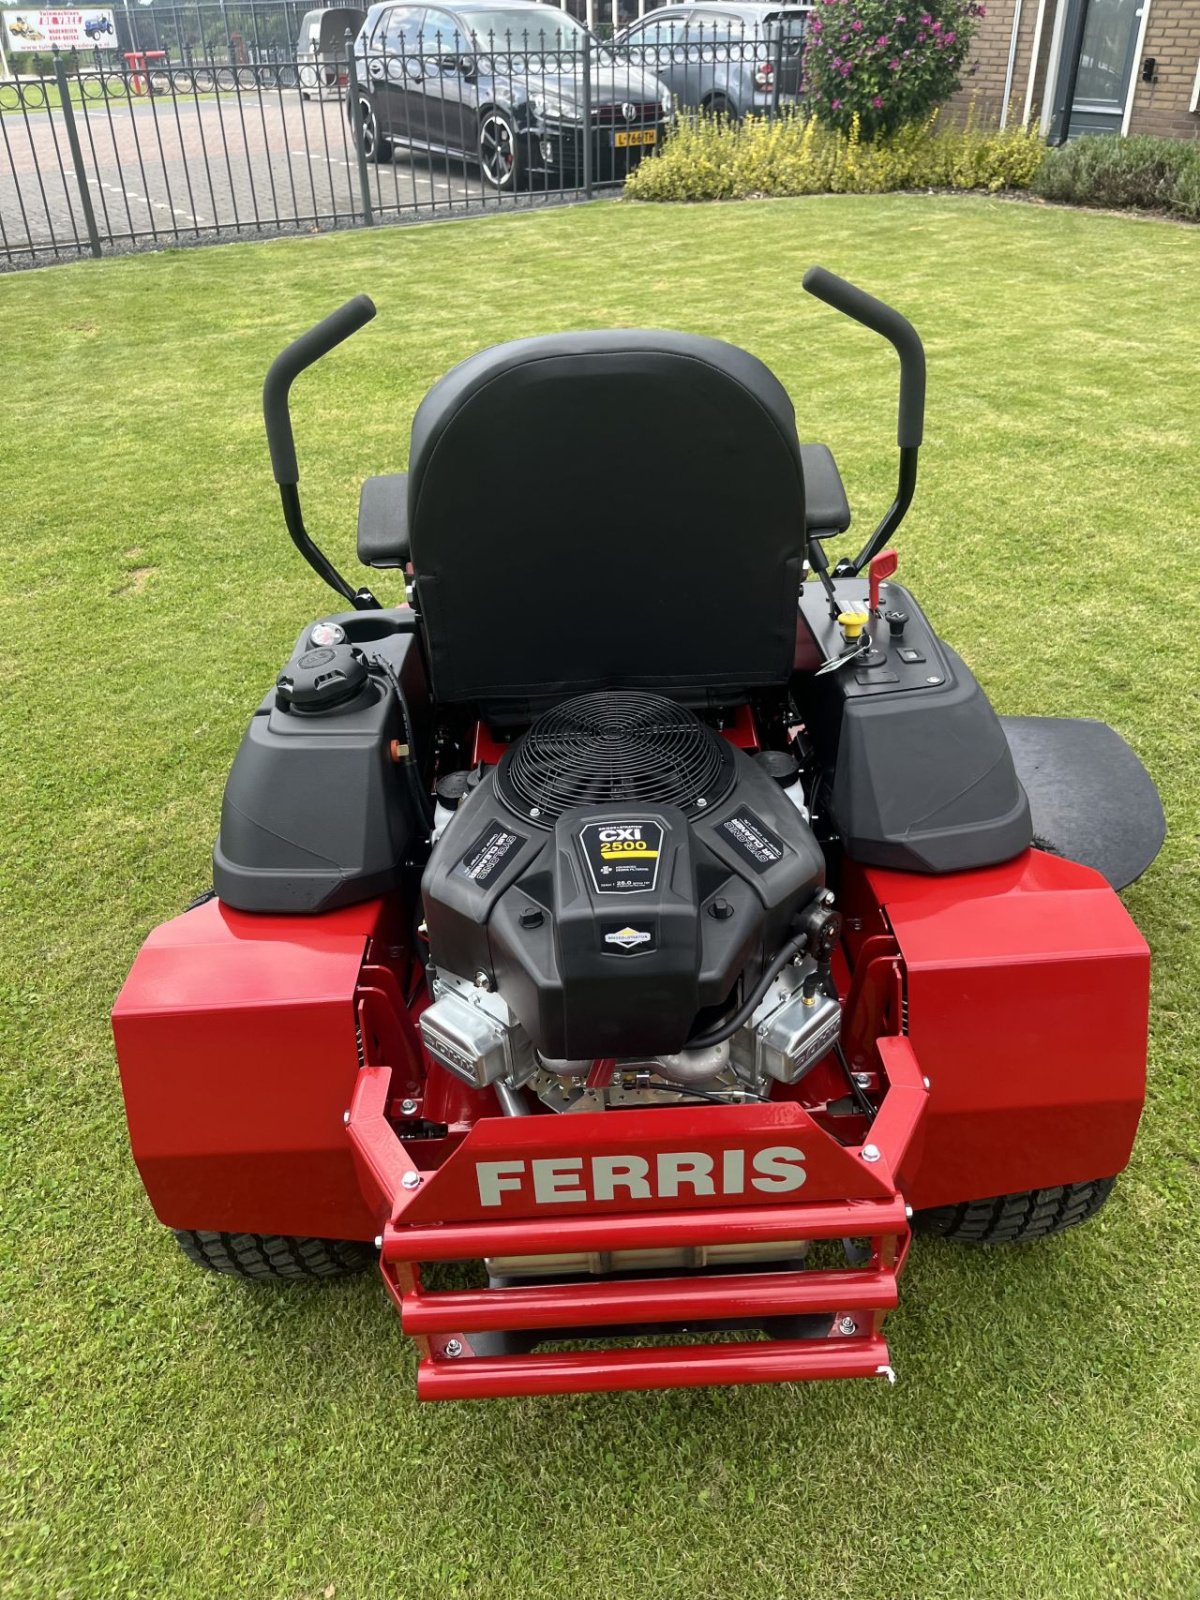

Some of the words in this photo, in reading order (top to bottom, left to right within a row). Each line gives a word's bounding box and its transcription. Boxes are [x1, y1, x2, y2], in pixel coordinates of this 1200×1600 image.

[599, 828, 642, 842] CXI
[731, 819, 764, 848] CLEANER
[600, 841, 647, 852] 2500
[761, 848, 777, 860] AIR
[468, 846, 499, 879] CLEANER
[475, 1146, 807, 1207] FERRIS
